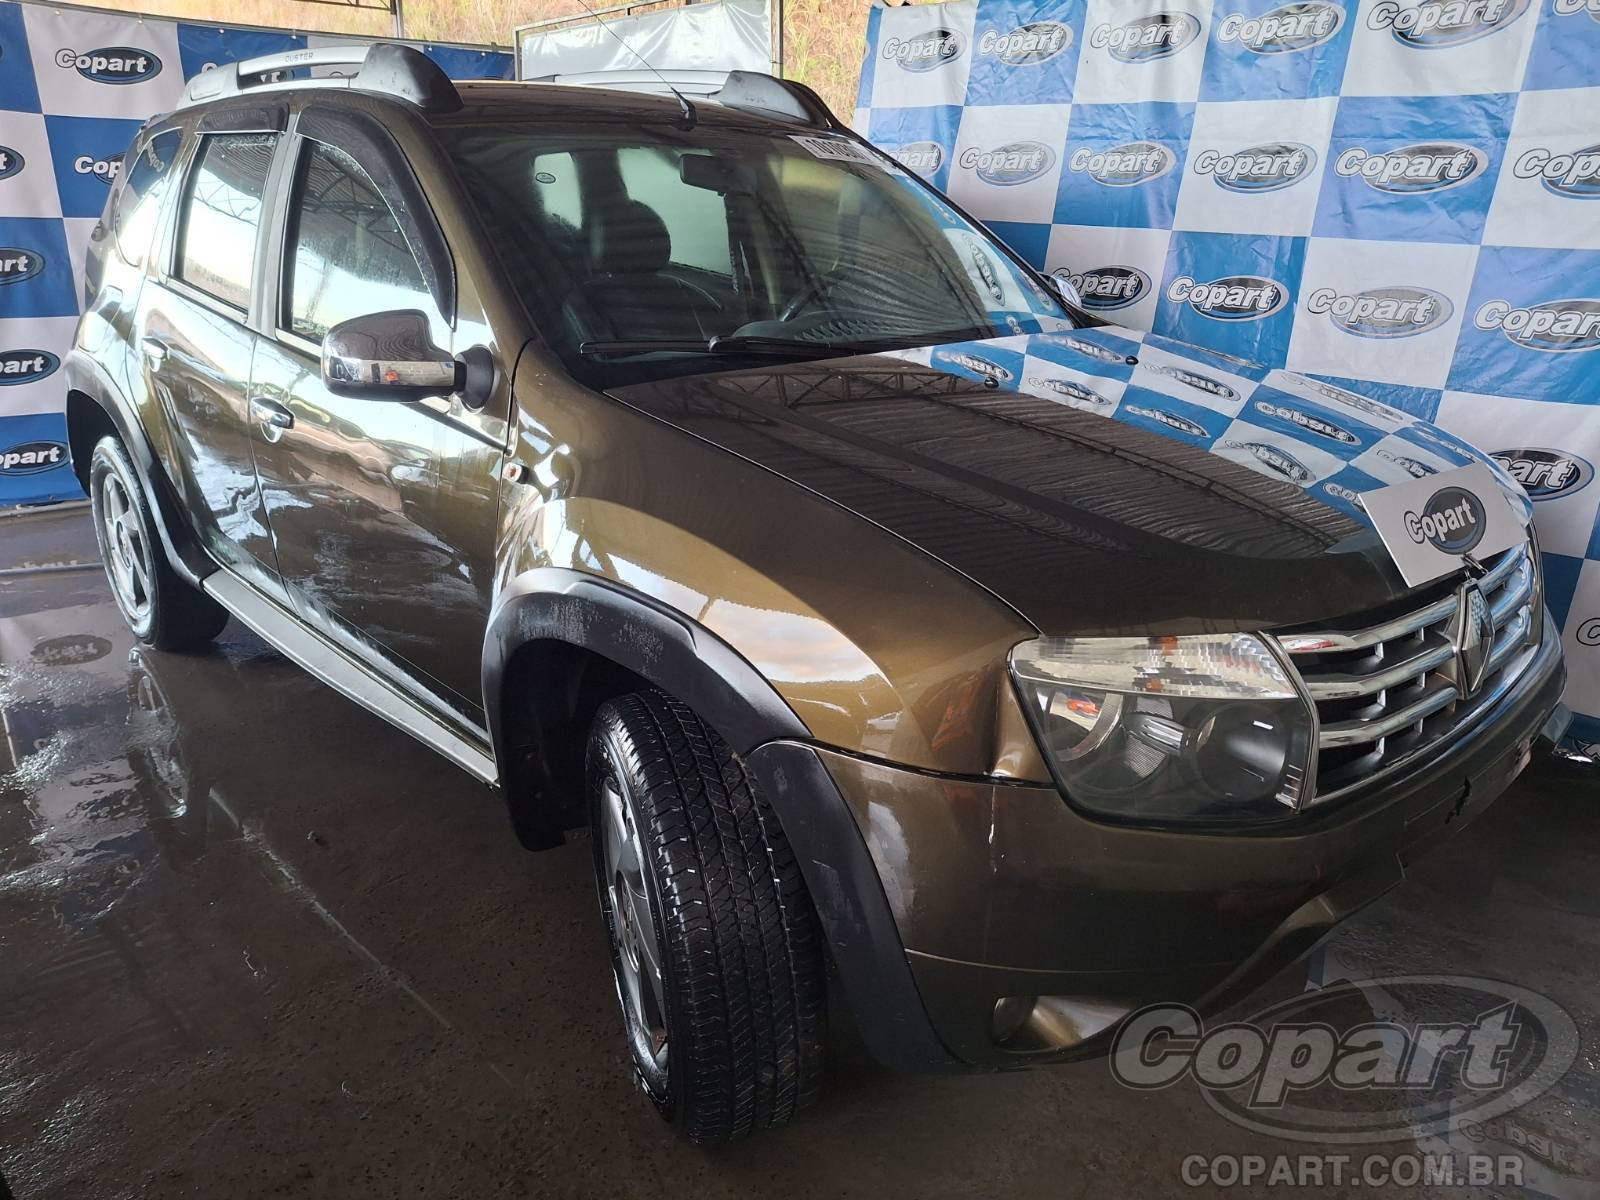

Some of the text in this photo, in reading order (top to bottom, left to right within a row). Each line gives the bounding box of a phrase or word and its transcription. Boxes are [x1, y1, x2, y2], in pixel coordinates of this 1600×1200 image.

[1090, 17, 1187, 53] Copart
[1217, 7, 1333, 48] Copart
[1367, 0, 1503, 37] Copart
[883, 34, 955, 64] Copart
[979, 22, 1066, 58] Copart
[55, 48, 147, 74] Copart
[74, 156, 125, 178] Cop
[960, 147, 1043, 173] Copart
[1070, 147, 1164, 174] Copart
[1193, 148, 1304, 183] Copart
[1334, 147, 1476, 186] Copart
[1513, 148, 1600, 186] Cop
[1167, 275, 1281, 309] Copart
[1306, 288, 1435, 325] Copart
[1473, 300, 1600, 340] Copar
[1403, 496, 1477, 544] Copart
